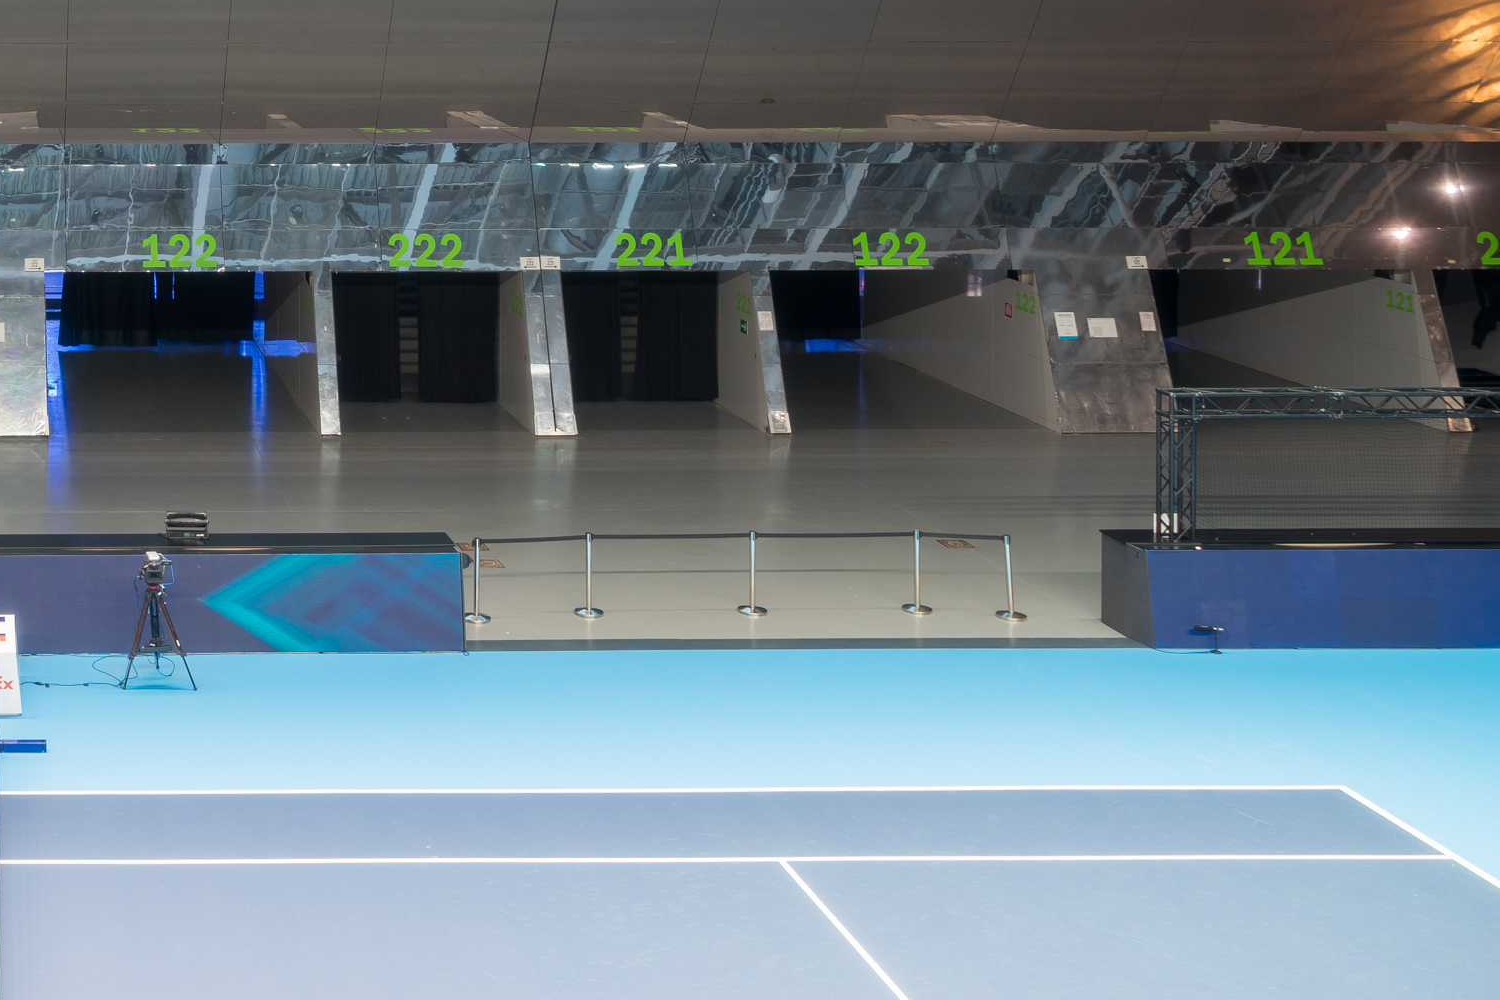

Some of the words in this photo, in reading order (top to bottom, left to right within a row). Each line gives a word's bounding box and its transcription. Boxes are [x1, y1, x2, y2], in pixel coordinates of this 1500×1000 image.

[142, 233, 217, 268] 122
[388, 233, 464, 267] 222
[615, 232, 692, 267] 221
[852, 231, 930, 267] 122
[1243, 231, 1324, 266] 121
[1015, 291, 1036, 315] 122
[1386, 290, 1415, 314] 121
